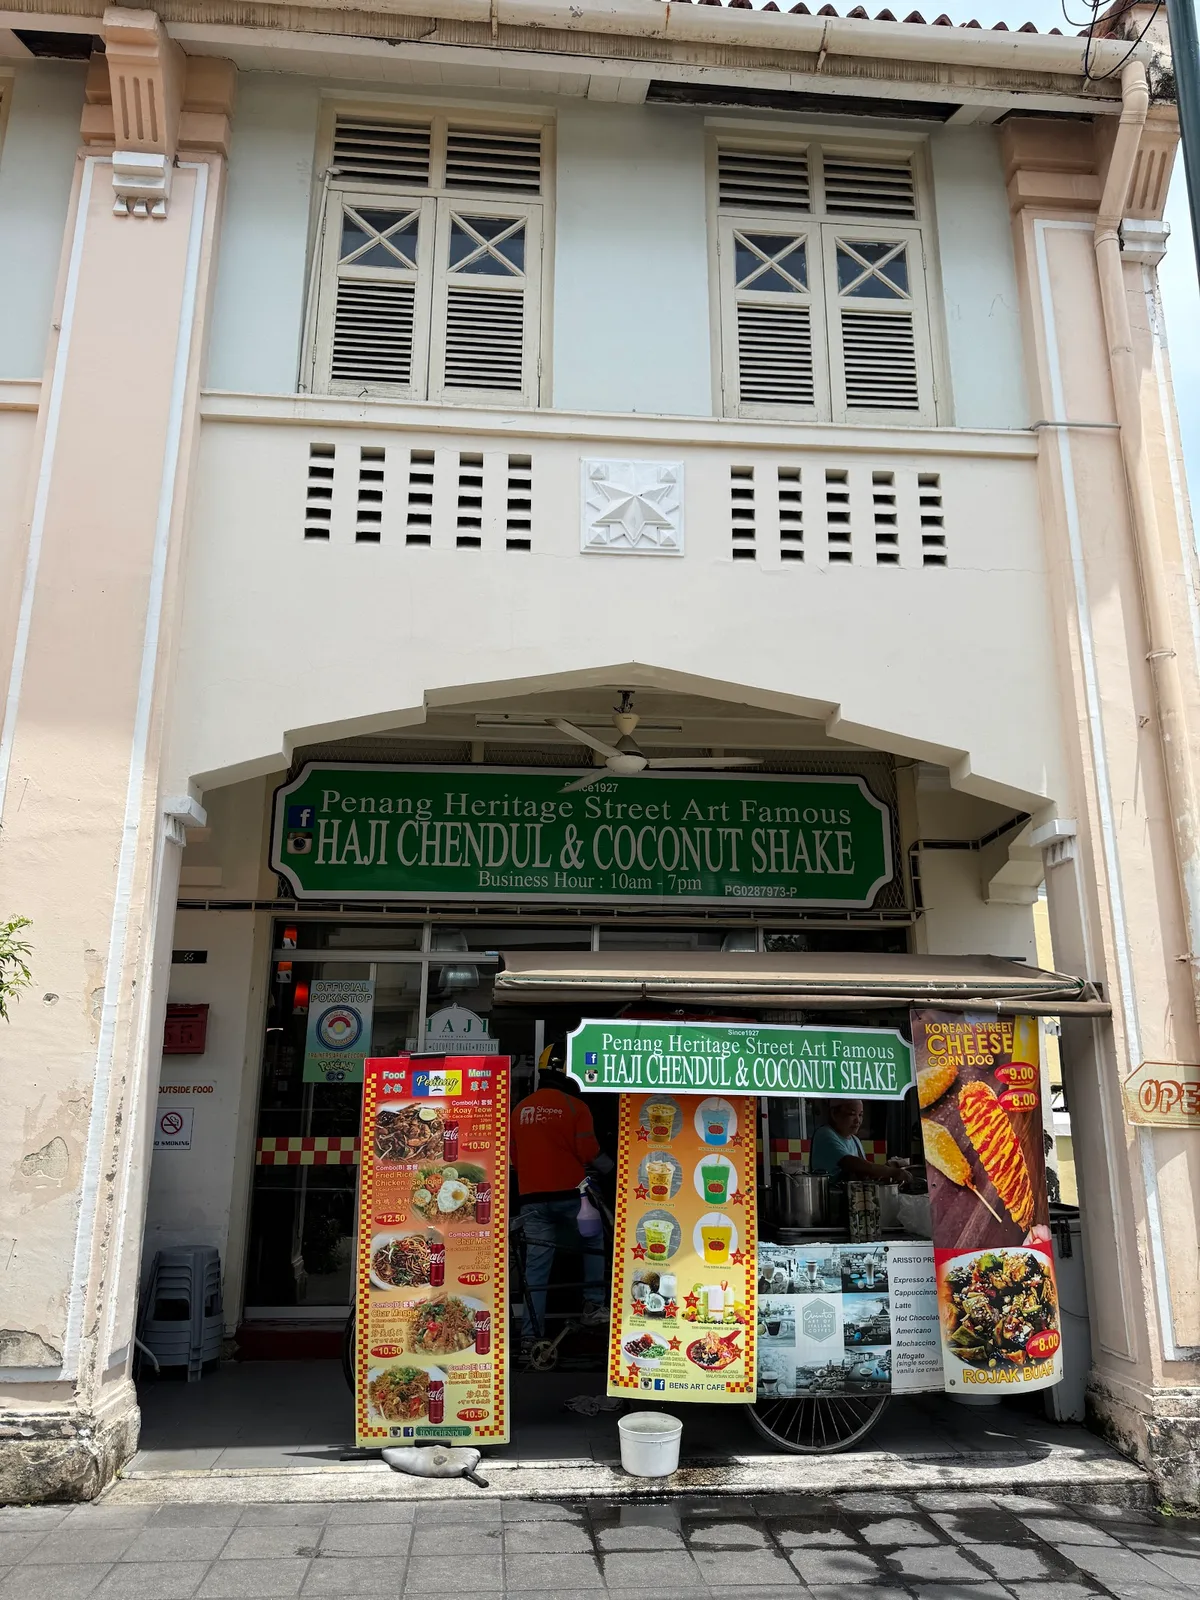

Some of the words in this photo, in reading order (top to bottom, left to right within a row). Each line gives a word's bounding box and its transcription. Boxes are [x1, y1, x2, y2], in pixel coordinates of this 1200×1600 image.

[320, 789, 433, 821] Penang
[444, 792, 574, 823] Heritage
[585, 795, 671, 821] Street
[681, 799, 730, 822] Art
[740, 800, 851, 825] Famous
[315, 818, 390, 866] HAJI
[397, 820, 552, 869] CHENDUL
[560, 823, 585, 870] &
[593, 824, 743, 872] COCONUT
[751, 828, 856, 875] SHAKE
[478, 870, 549, 888] Business
[554, 871, 595, 889] Hour
[610, 872, 653, 890] 10am
[668, 873, 702, 894] 7pm
[724, 884, 798, 898] PG0287973-P
[316, 982, 368, 994] OFFICIAL
[925, 1022, 972, 1034] KOREAN
[975, 1021, 1013, 1033] STREET
[727, 1029, 760, 1038] Since1927
[602, 1033, 664, 1055] Penang
[669, 1034, 741, 1057] Heritage
[746, 1036, 795, 1056] Street
[800, 1038, 828, 1056] Art
[831, 1040, 894, 1059] Famous
[927, 1033, 1013, 1055] CHEESE
[928, 1055, 965, 1067] CORN
[967, 1054, 995, 1066] DOG
[382, 1070, 406, 1080] Food
[468, 1069, 491, 1078] Menu
[603, 1053, 643, 1084] HAJI
[646, 1055, 732, 1086] CHENDUL
[736, 1056, 750, 1087] &
[753, 1057, 837, 1089] COCONUT
[841, 1061, 898, 1091] SHAKE
[416, 1074, 459, 1092] Penang
[192, 1085, 214, 1094] FOOD
[453, 1107, 473, 1115] Koay
[536, 1105, 563, 1115] Shopee
[375, 1171, 395, 1179] Fried
[375, 1179, 405, 1187] Chicken
[892, 1256, 922, 1264] ARISSTO
[893, 1276, 925, 1284] Expresso
[895, 1314, 908, 1322] Hot
[895, 1327, 932, 1335] Americano
[896, 1352, 925, 1360] Affogato
[962, 1368, 1021, 1384] ROJAK
[669, 1382, 689, 1390] BENS
[690, 1382, 705, 1390] ART
[706, 1383, 726, 1391] CAFE
